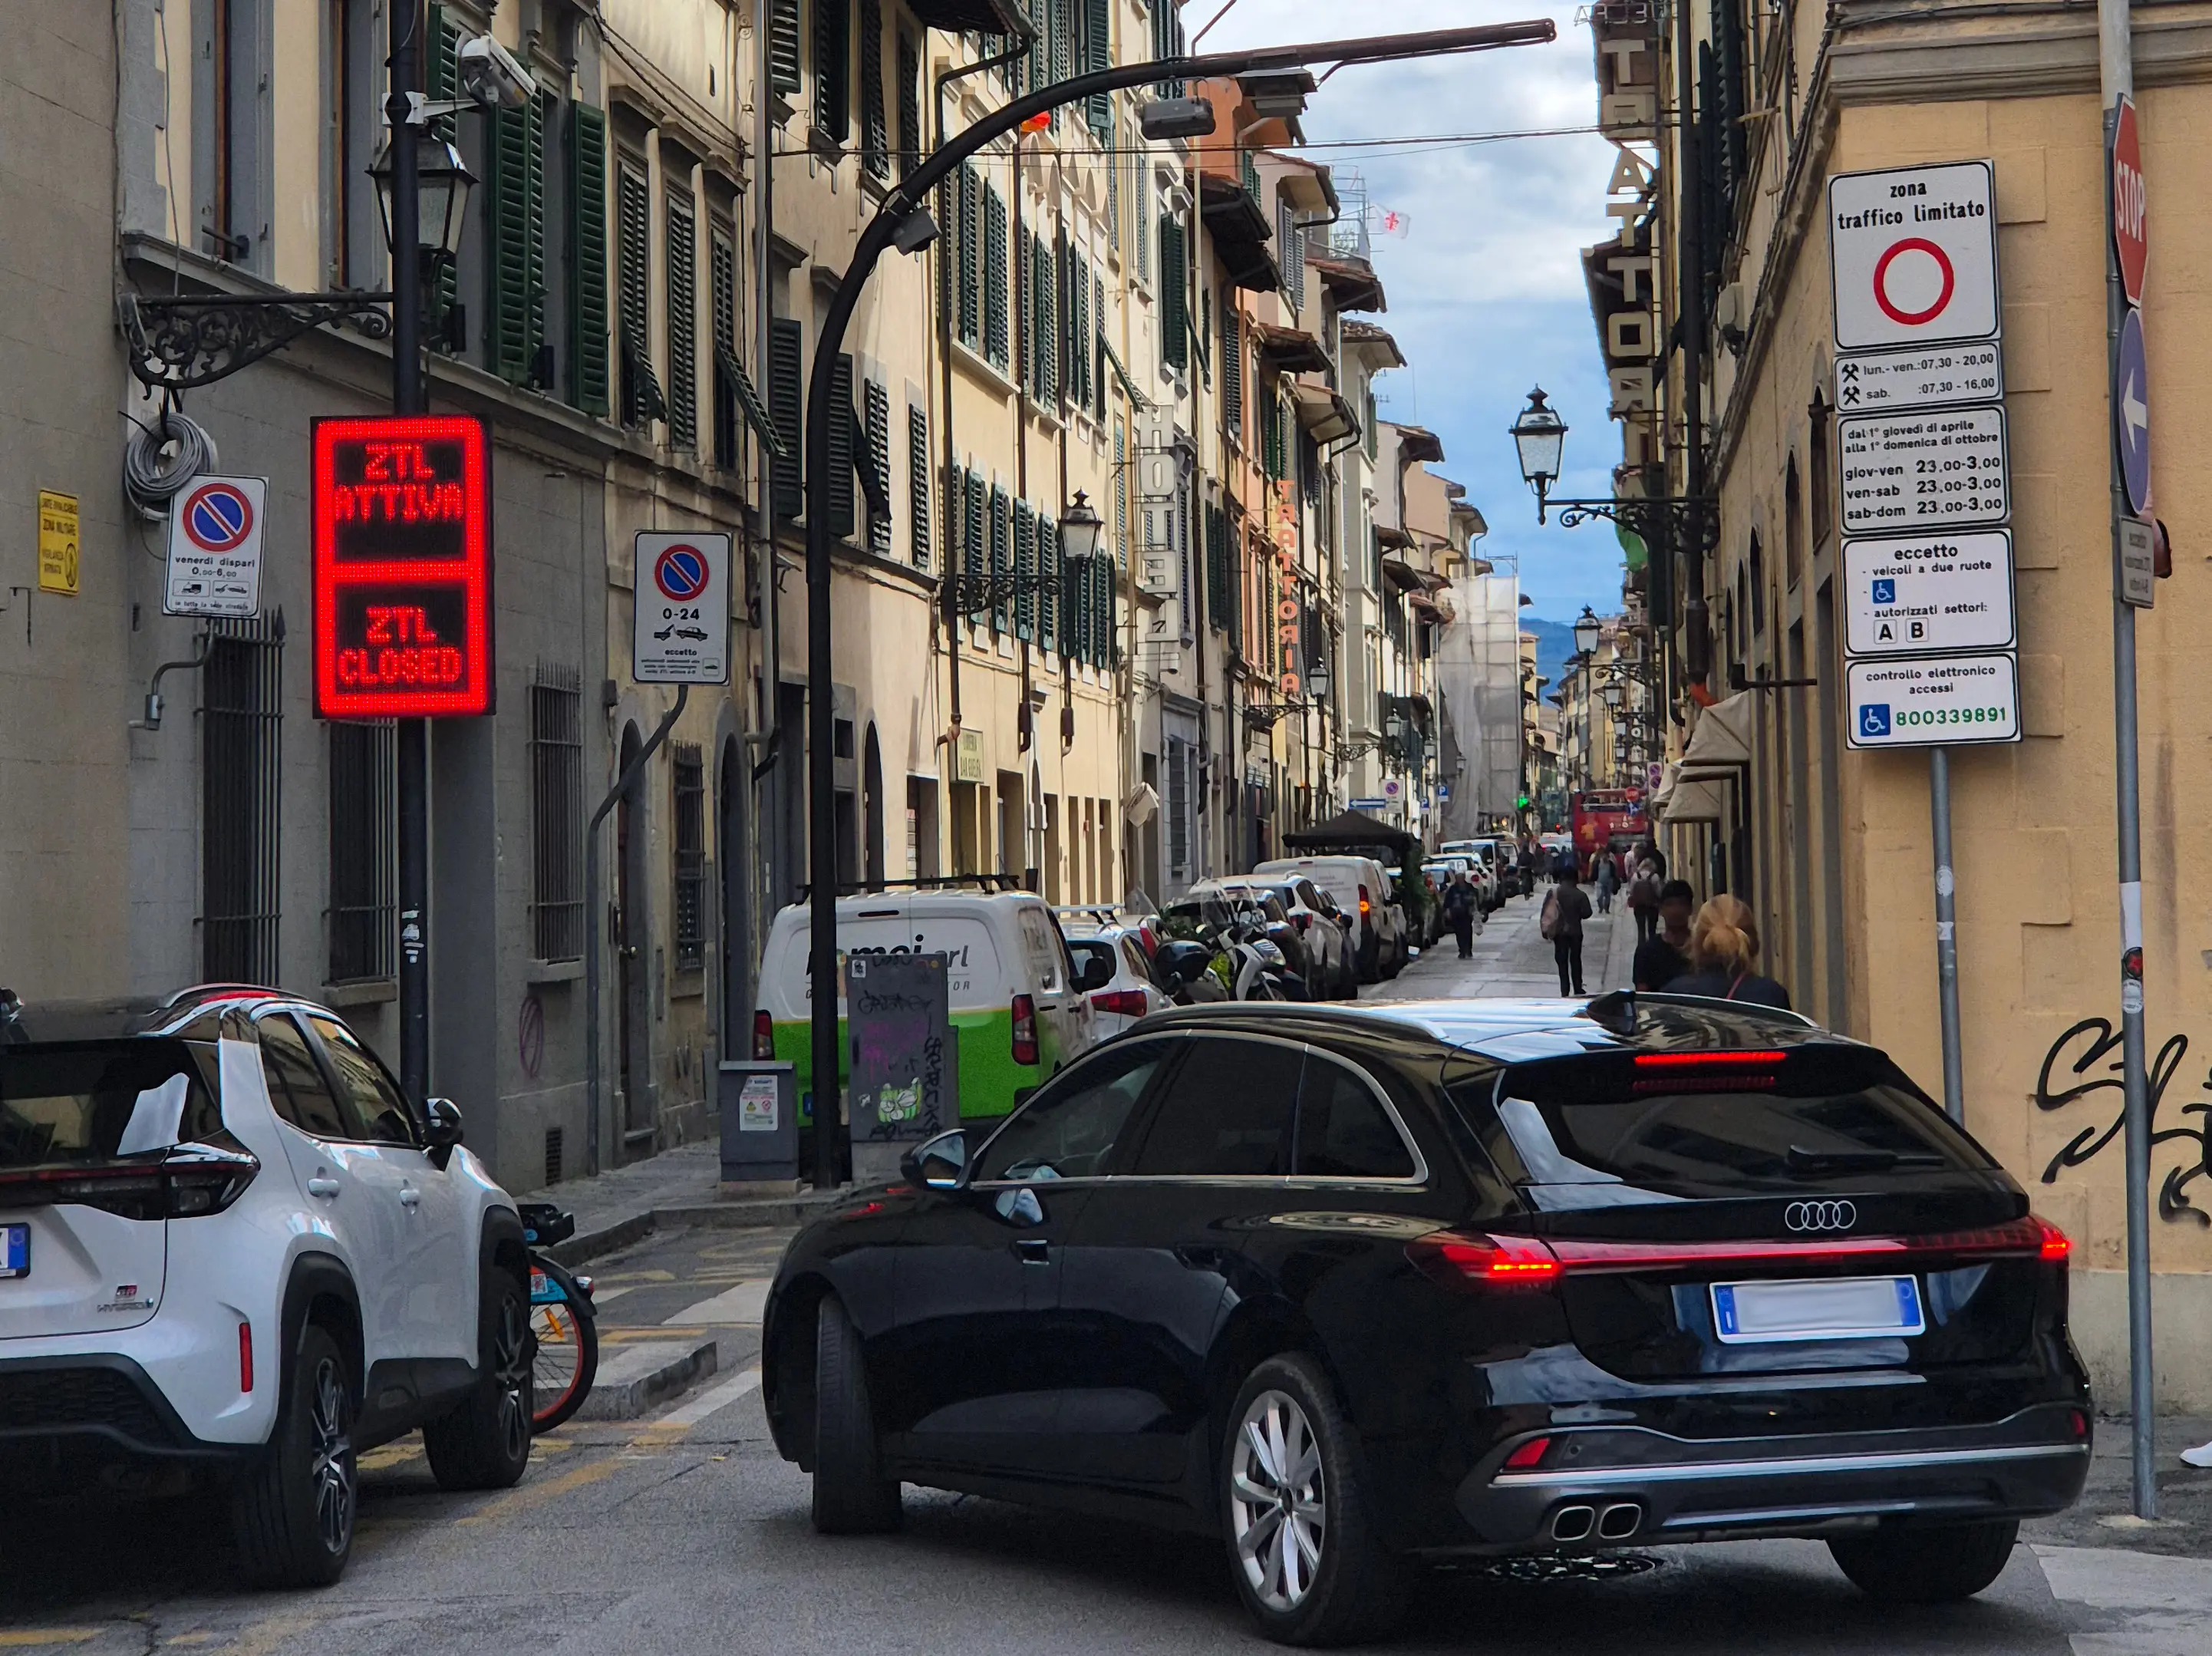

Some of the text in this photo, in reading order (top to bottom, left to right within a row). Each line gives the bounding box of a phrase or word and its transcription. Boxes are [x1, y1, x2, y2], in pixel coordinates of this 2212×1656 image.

[1890, 182, 1927, 198] zona
[2117, 159, 2144, 242] STOP
[1837, 200, 1984, 229] traffico limitato
[1963, 353, 1993, 367] 20,00
[1866, 388, 1891, 399] sab.
[1964, 378, 1994, 391] 16,00
[1848, 429, 1866, 440] dal
[1927, 423, 1937, 433] di
[1941, 421, 1974, 433] aprile
[1845, 441, 1866, 454] alla
[1884, 437, 1937, 450] domenica
[1941, 435, 1951, 445] di
[1955, 434, 1998, 444] ottobre
[365, 441, 435, 480] ZTL
[1845, 465, 1904, 481] giov-ven
[1846, 484, 1900, 499] ven-sab
[335, 483, 464, 522] ATTIVA
[1847, 505, 1906, 520] sab-dom
[1894, 543, 1958, 560] eccetto
[219, 556, 255, 569] dispari
[1872, 564, 1911, 576] veicoli
[1931, 562, 1953, 573] due
[1960, 560, 1992, 571] ruote
[663, 608, 700, 620] 0-24
[1874, 605, 1937, 618] autorizzati
[1944, 602, 1989, 614] settori:
[366, 605, 437, 643] ZTL
[1878, 622, 1924, 640] A B
[338, 647, 461, 683] CLOSED
[1866, 665, 1996, 681] controllo elettronico
[1909, 683, 1953, 694] accessi
[1896, 707, 2006, 726] 800339891
